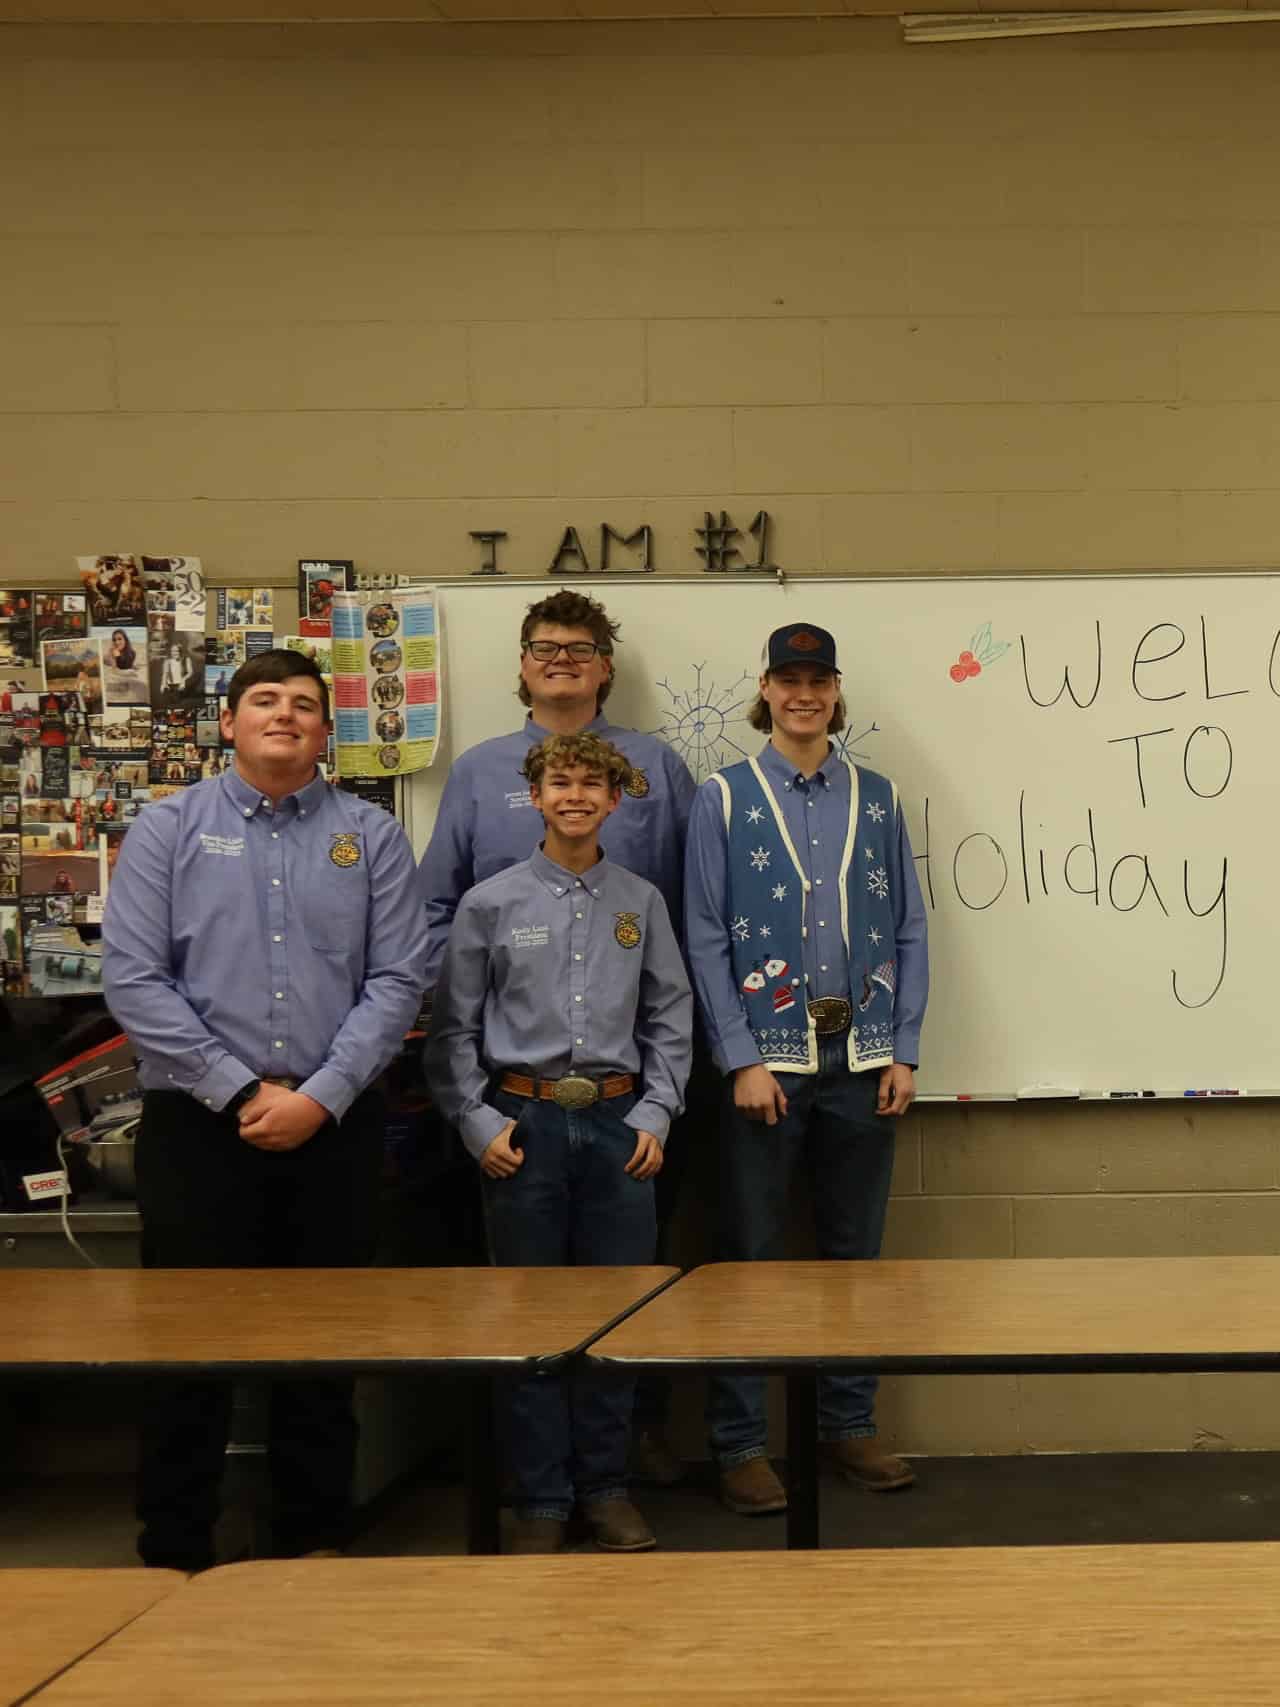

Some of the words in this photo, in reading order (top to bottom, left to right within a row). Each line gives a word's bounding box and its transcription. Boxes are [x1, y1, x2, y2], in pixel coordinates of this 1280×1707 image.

[468, 531, 507, 575] I
[548, 523, 653, 572] AM
[695, 511, 776, 571] #1
